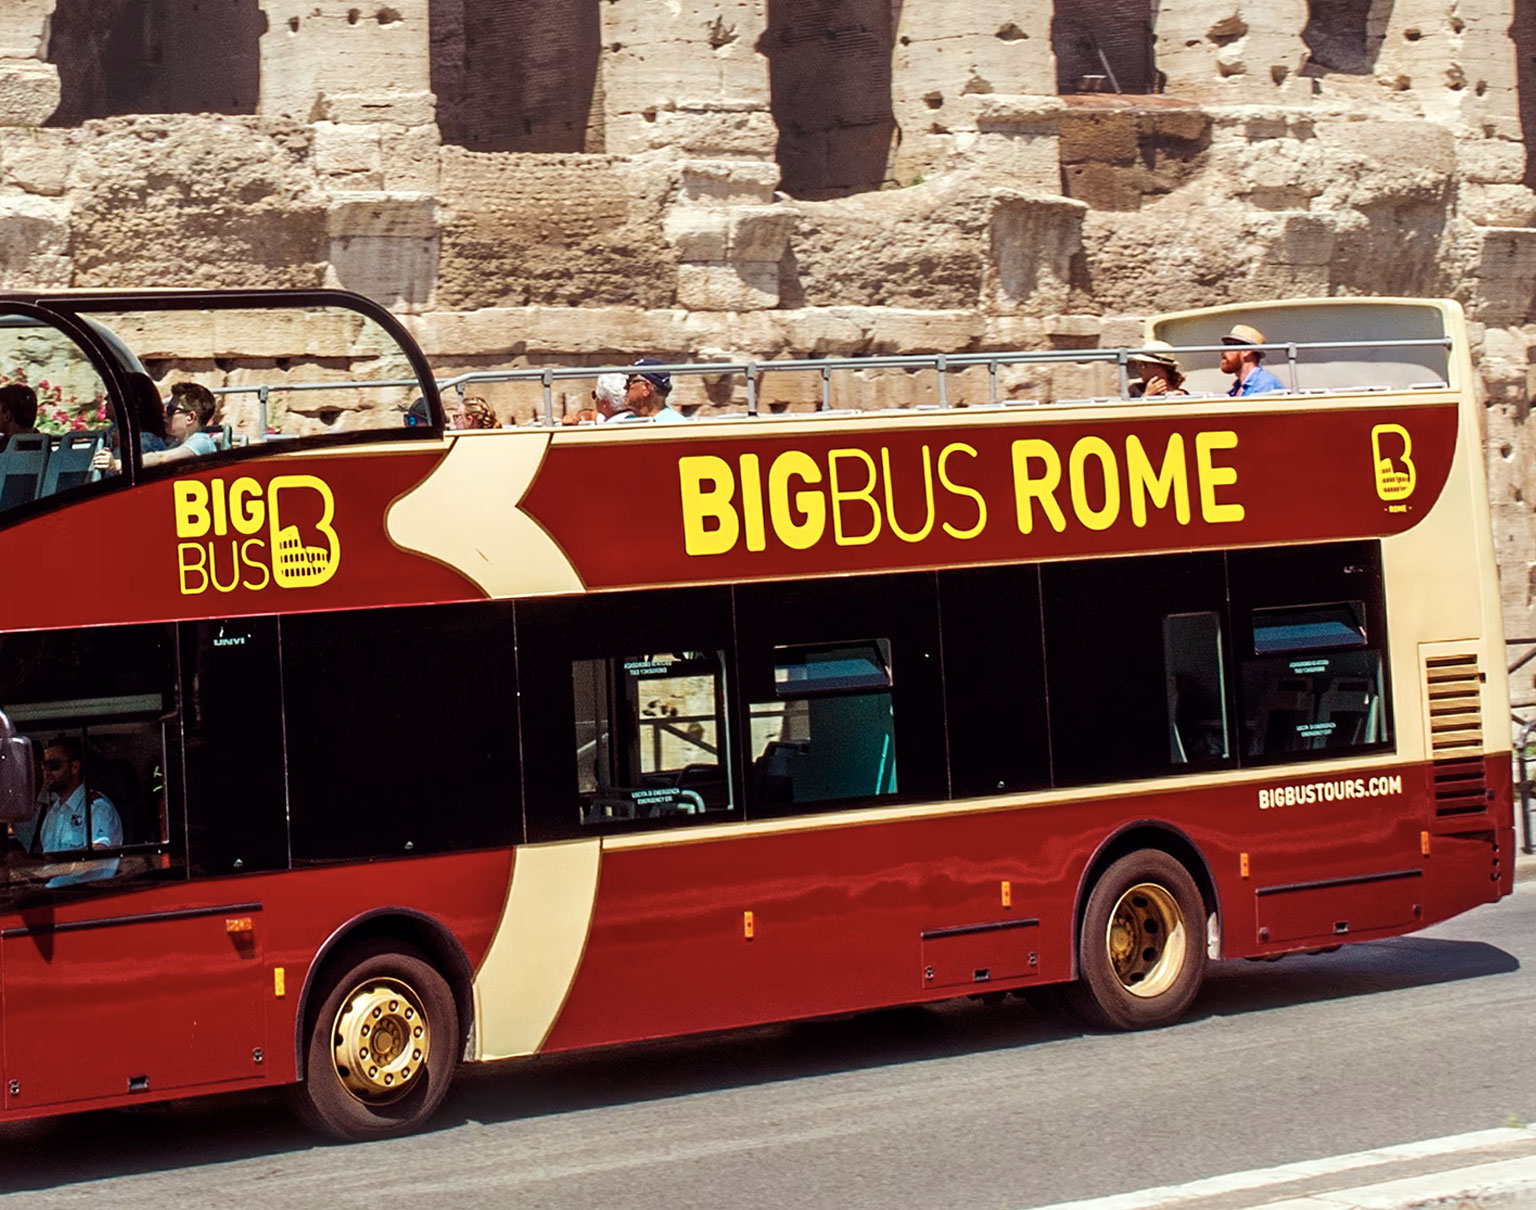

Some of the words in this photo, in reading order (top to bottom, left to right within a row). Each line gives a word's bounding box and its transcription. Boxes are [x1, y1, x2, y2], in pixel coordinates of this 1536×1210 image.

[173, 476, 265, 538] BIG
[1011, 430, 1245, 536] ROME
[177, 538, 270, 595] BUS
[1258, 775, 1403, 810] BIGBUSTOURS.COM
